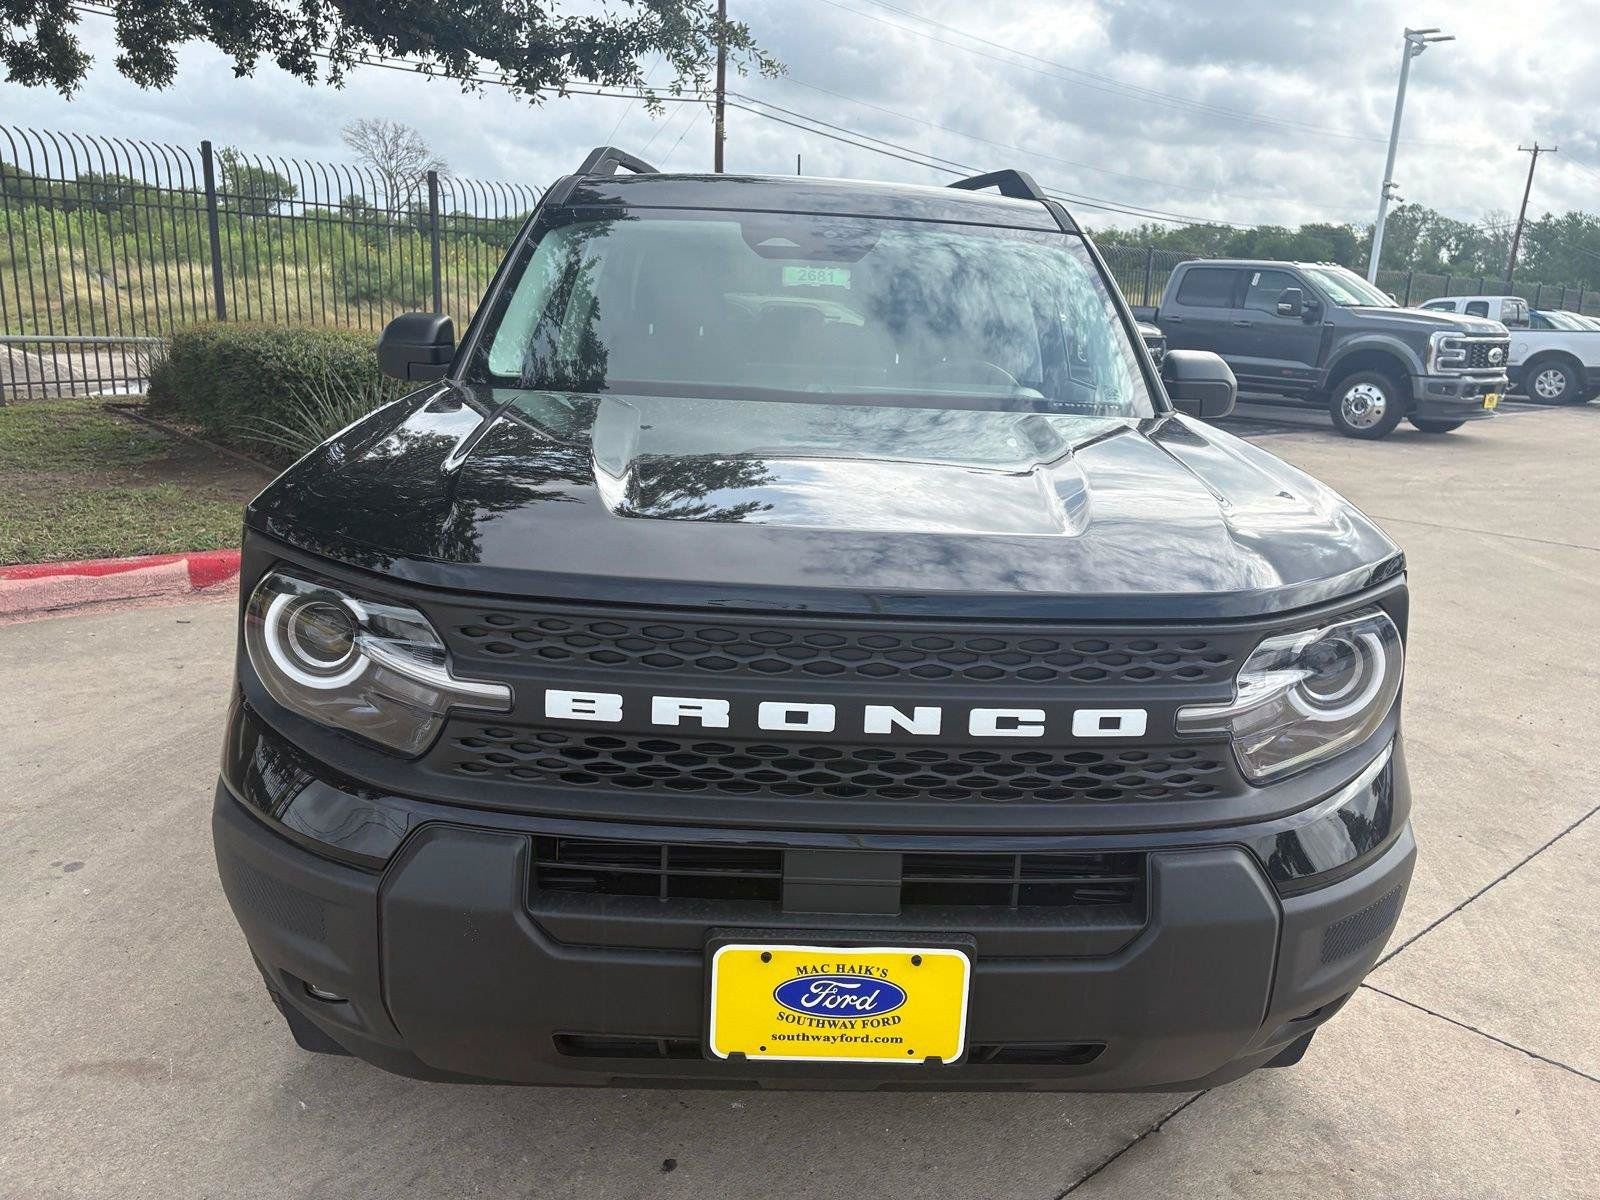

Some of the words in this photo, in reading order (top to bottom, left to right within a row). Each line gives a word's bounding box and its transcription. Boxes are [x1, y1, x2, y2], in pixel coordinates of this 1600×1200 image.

[798, 270, 834, 282] 2681
[545, 689, 1148, 738] BRONCO
[796, 963, 830, 976] MAC
[836, 963, 888, 978] HAIK'S
[800, 980, 881, 1011] Ford
[777, 1011, 857, 1029] SOUTHWAY
[861, 1015, 901, 1029] FORD
[771, 1033, 903, 1044] southwayford.com
